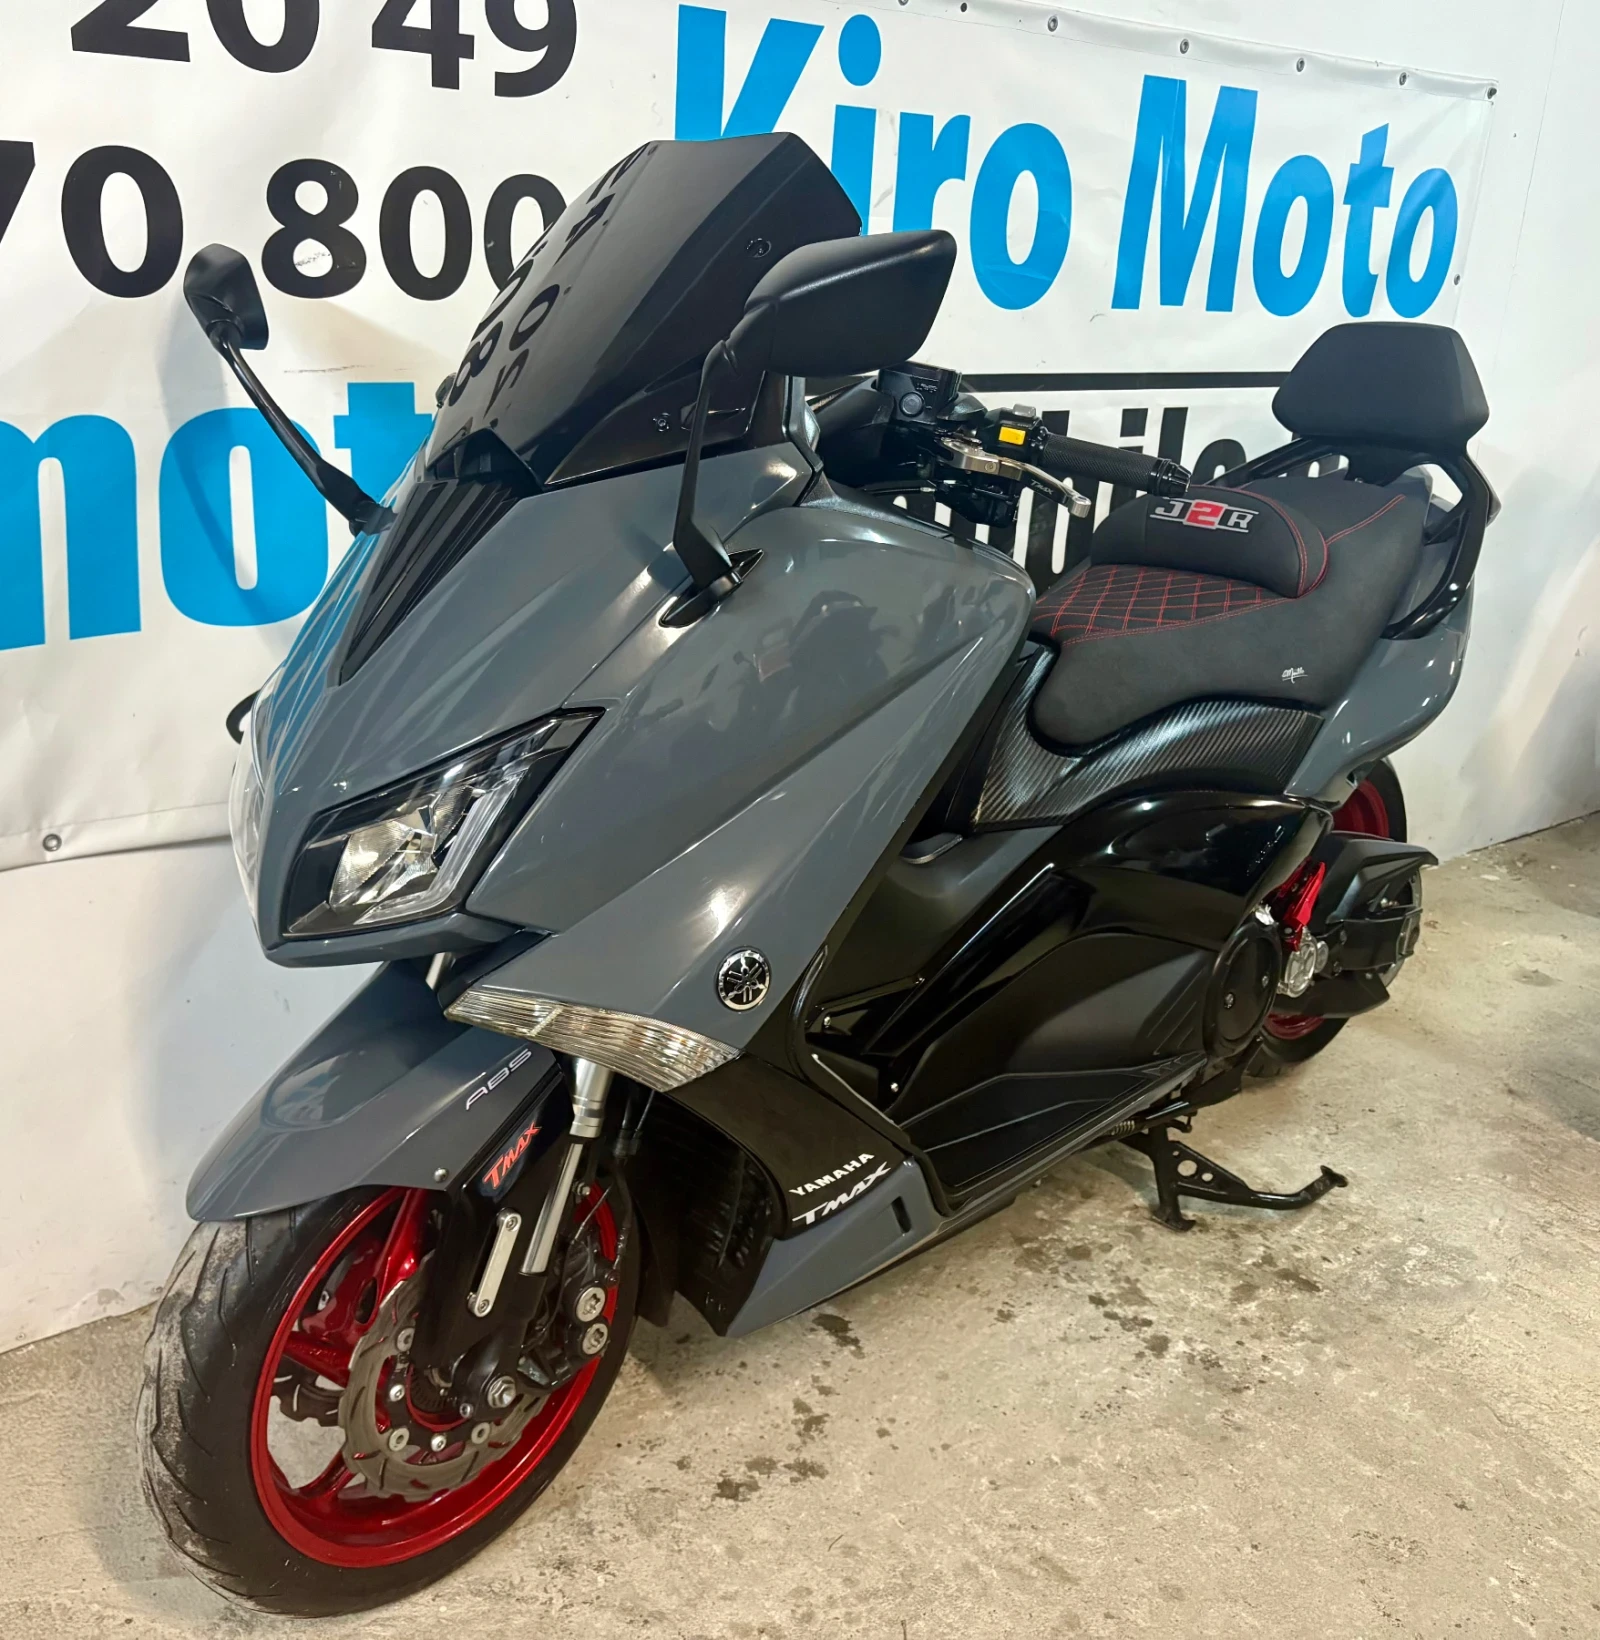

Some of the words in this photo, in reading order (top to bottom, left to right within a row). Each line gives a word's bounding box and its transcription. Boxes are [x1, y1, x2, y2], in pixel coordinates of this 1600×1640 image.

[371, 0, 577, 98] 49
[261, 158, 567, 301] 800
[1111, 75, 1458, 318] Moto
[1154, 499, 1255, 530] J2R
[466, 1048, 532, 1110] ABS
[482, 1121, 542, 1190] TMAX
[788, 1153, 875, 1196] YAMAHA
[791, 1161, 891, 1225] TMAX
